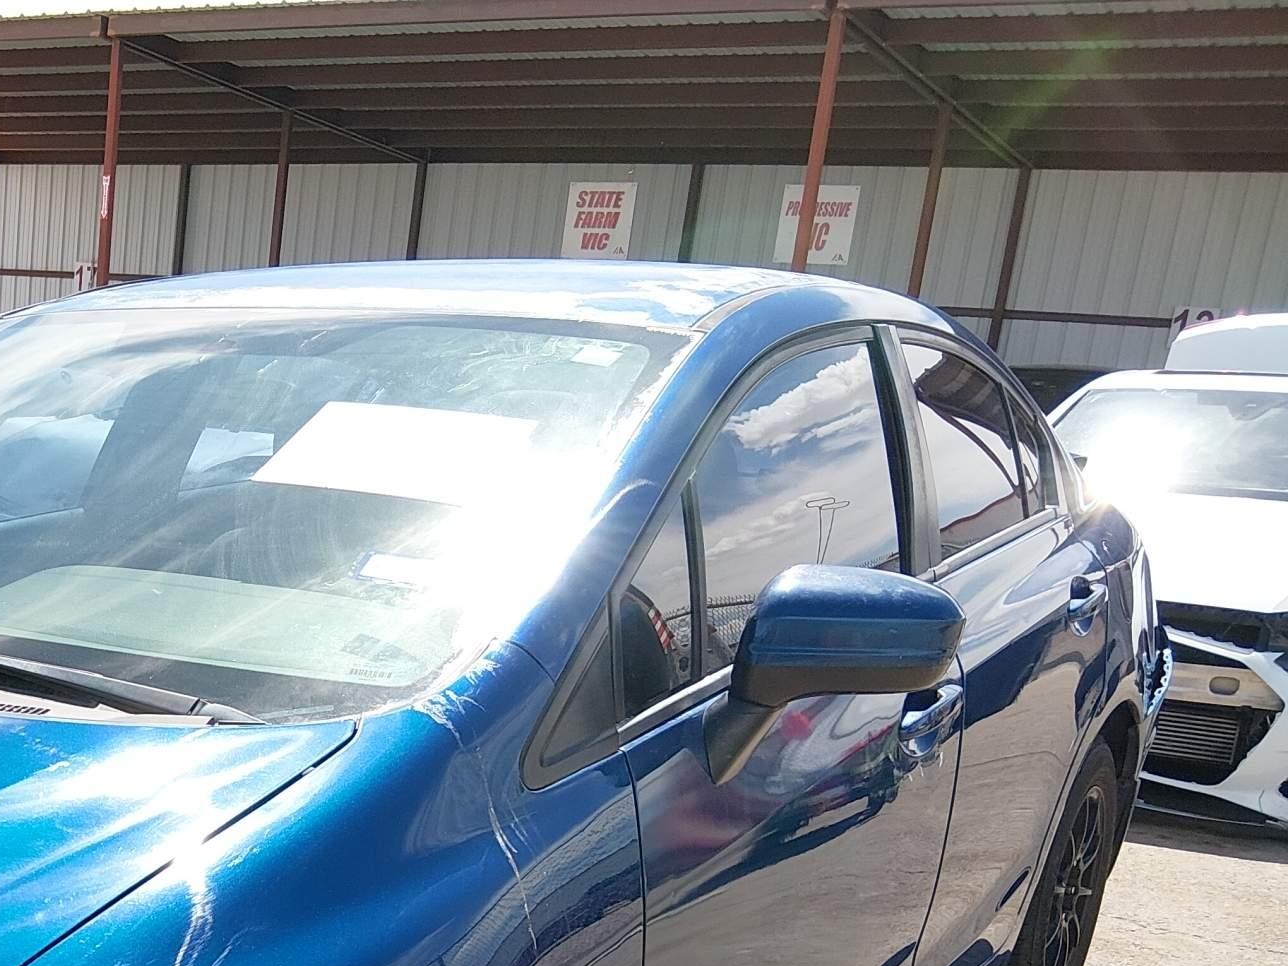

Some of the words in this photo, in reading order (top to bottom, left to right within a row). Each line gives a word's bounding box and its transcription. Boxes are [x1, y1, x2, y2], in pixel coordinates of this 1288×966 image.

[576, 190, 625, 209] STATE
[573, 211, 621, 229] FARM
[580, 232, 610, 251] VIC
